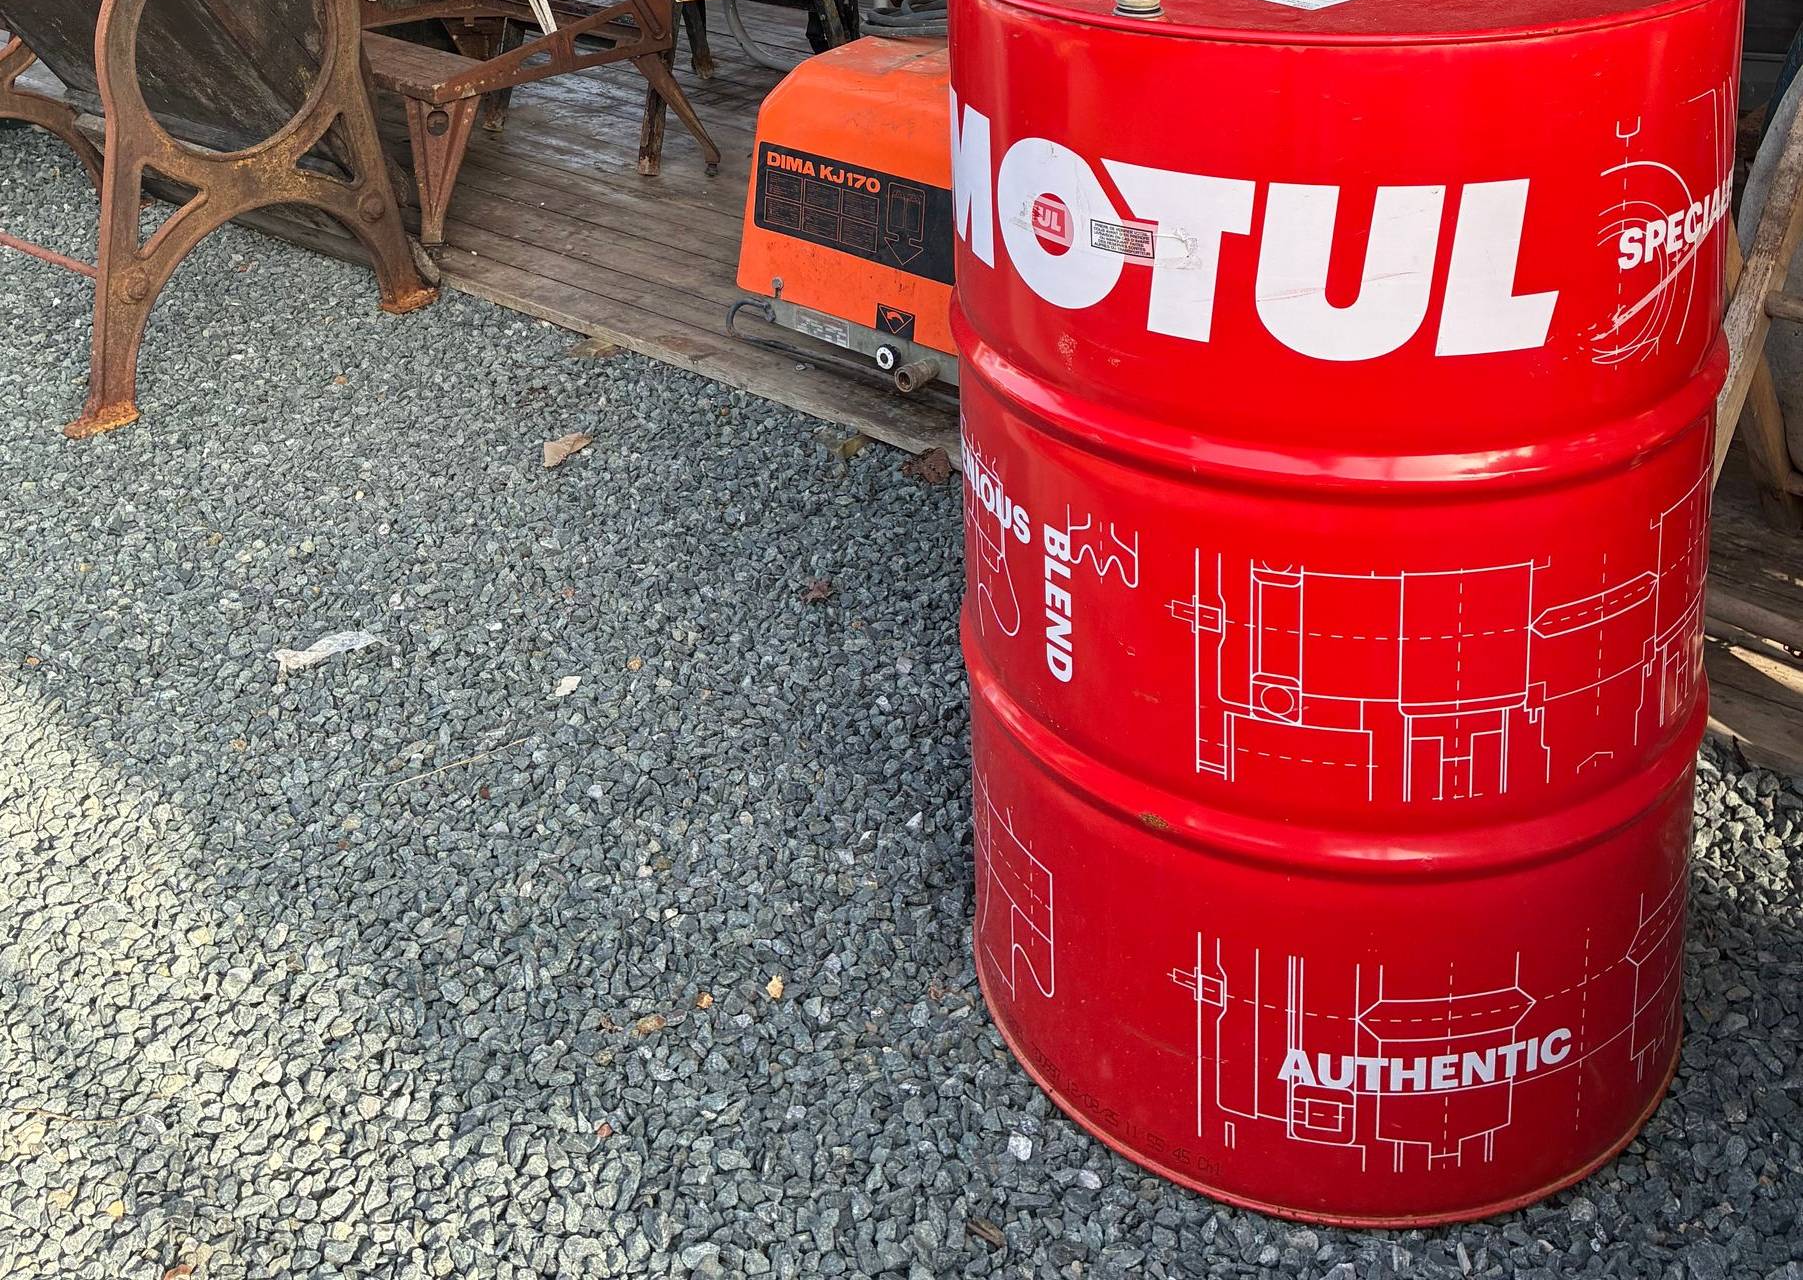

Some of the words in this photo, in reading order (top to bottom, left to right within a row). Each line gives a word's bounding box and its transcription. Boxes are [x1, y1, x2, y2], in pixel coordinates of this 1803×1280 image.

[766, 151, 816, 177] DIMA
[820, 164, 881, 193] KJ170
[949, 81, 1559, 361] MOTUL
[1043, 522, 1073, 683] BLEND
[1277, 1027, 1572, 1091] AUTHENTIC
